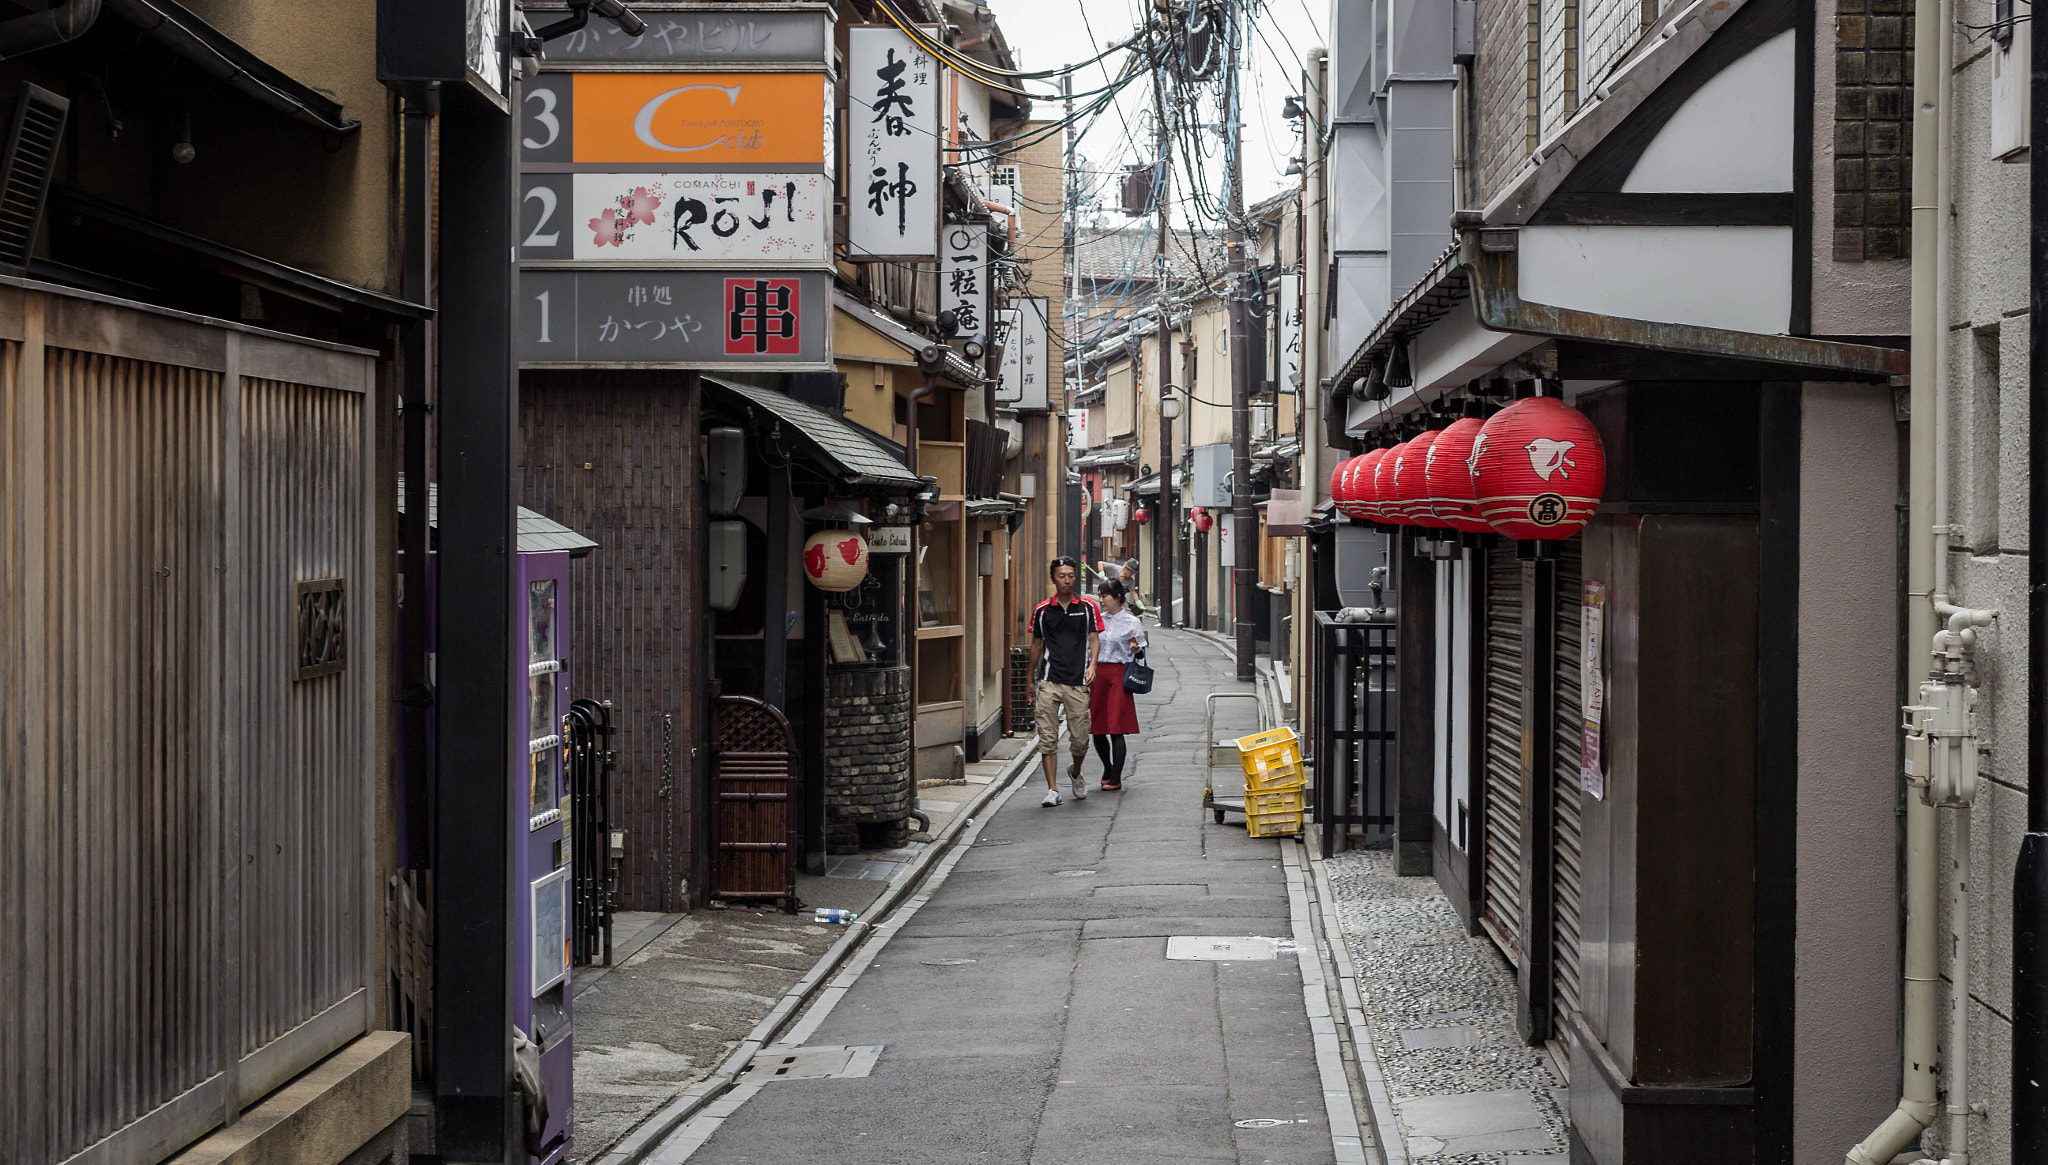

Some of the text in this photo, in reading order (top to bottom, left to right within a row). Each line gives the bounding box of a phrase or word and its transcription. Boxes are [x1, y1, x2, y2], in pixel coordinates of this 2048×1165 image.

[566, 18, 771, 56] かつやビル
[522, 88, 560, 150] 3
[674, 181, 741, 189] COMANCHI
[522, 186, 559, 247] 2
[534, 290, 553, 343] 1
[627, 285, 673, 308] 串処
[729, 279, 796, 353] 串
[599, 314, 702, 343] かつや
